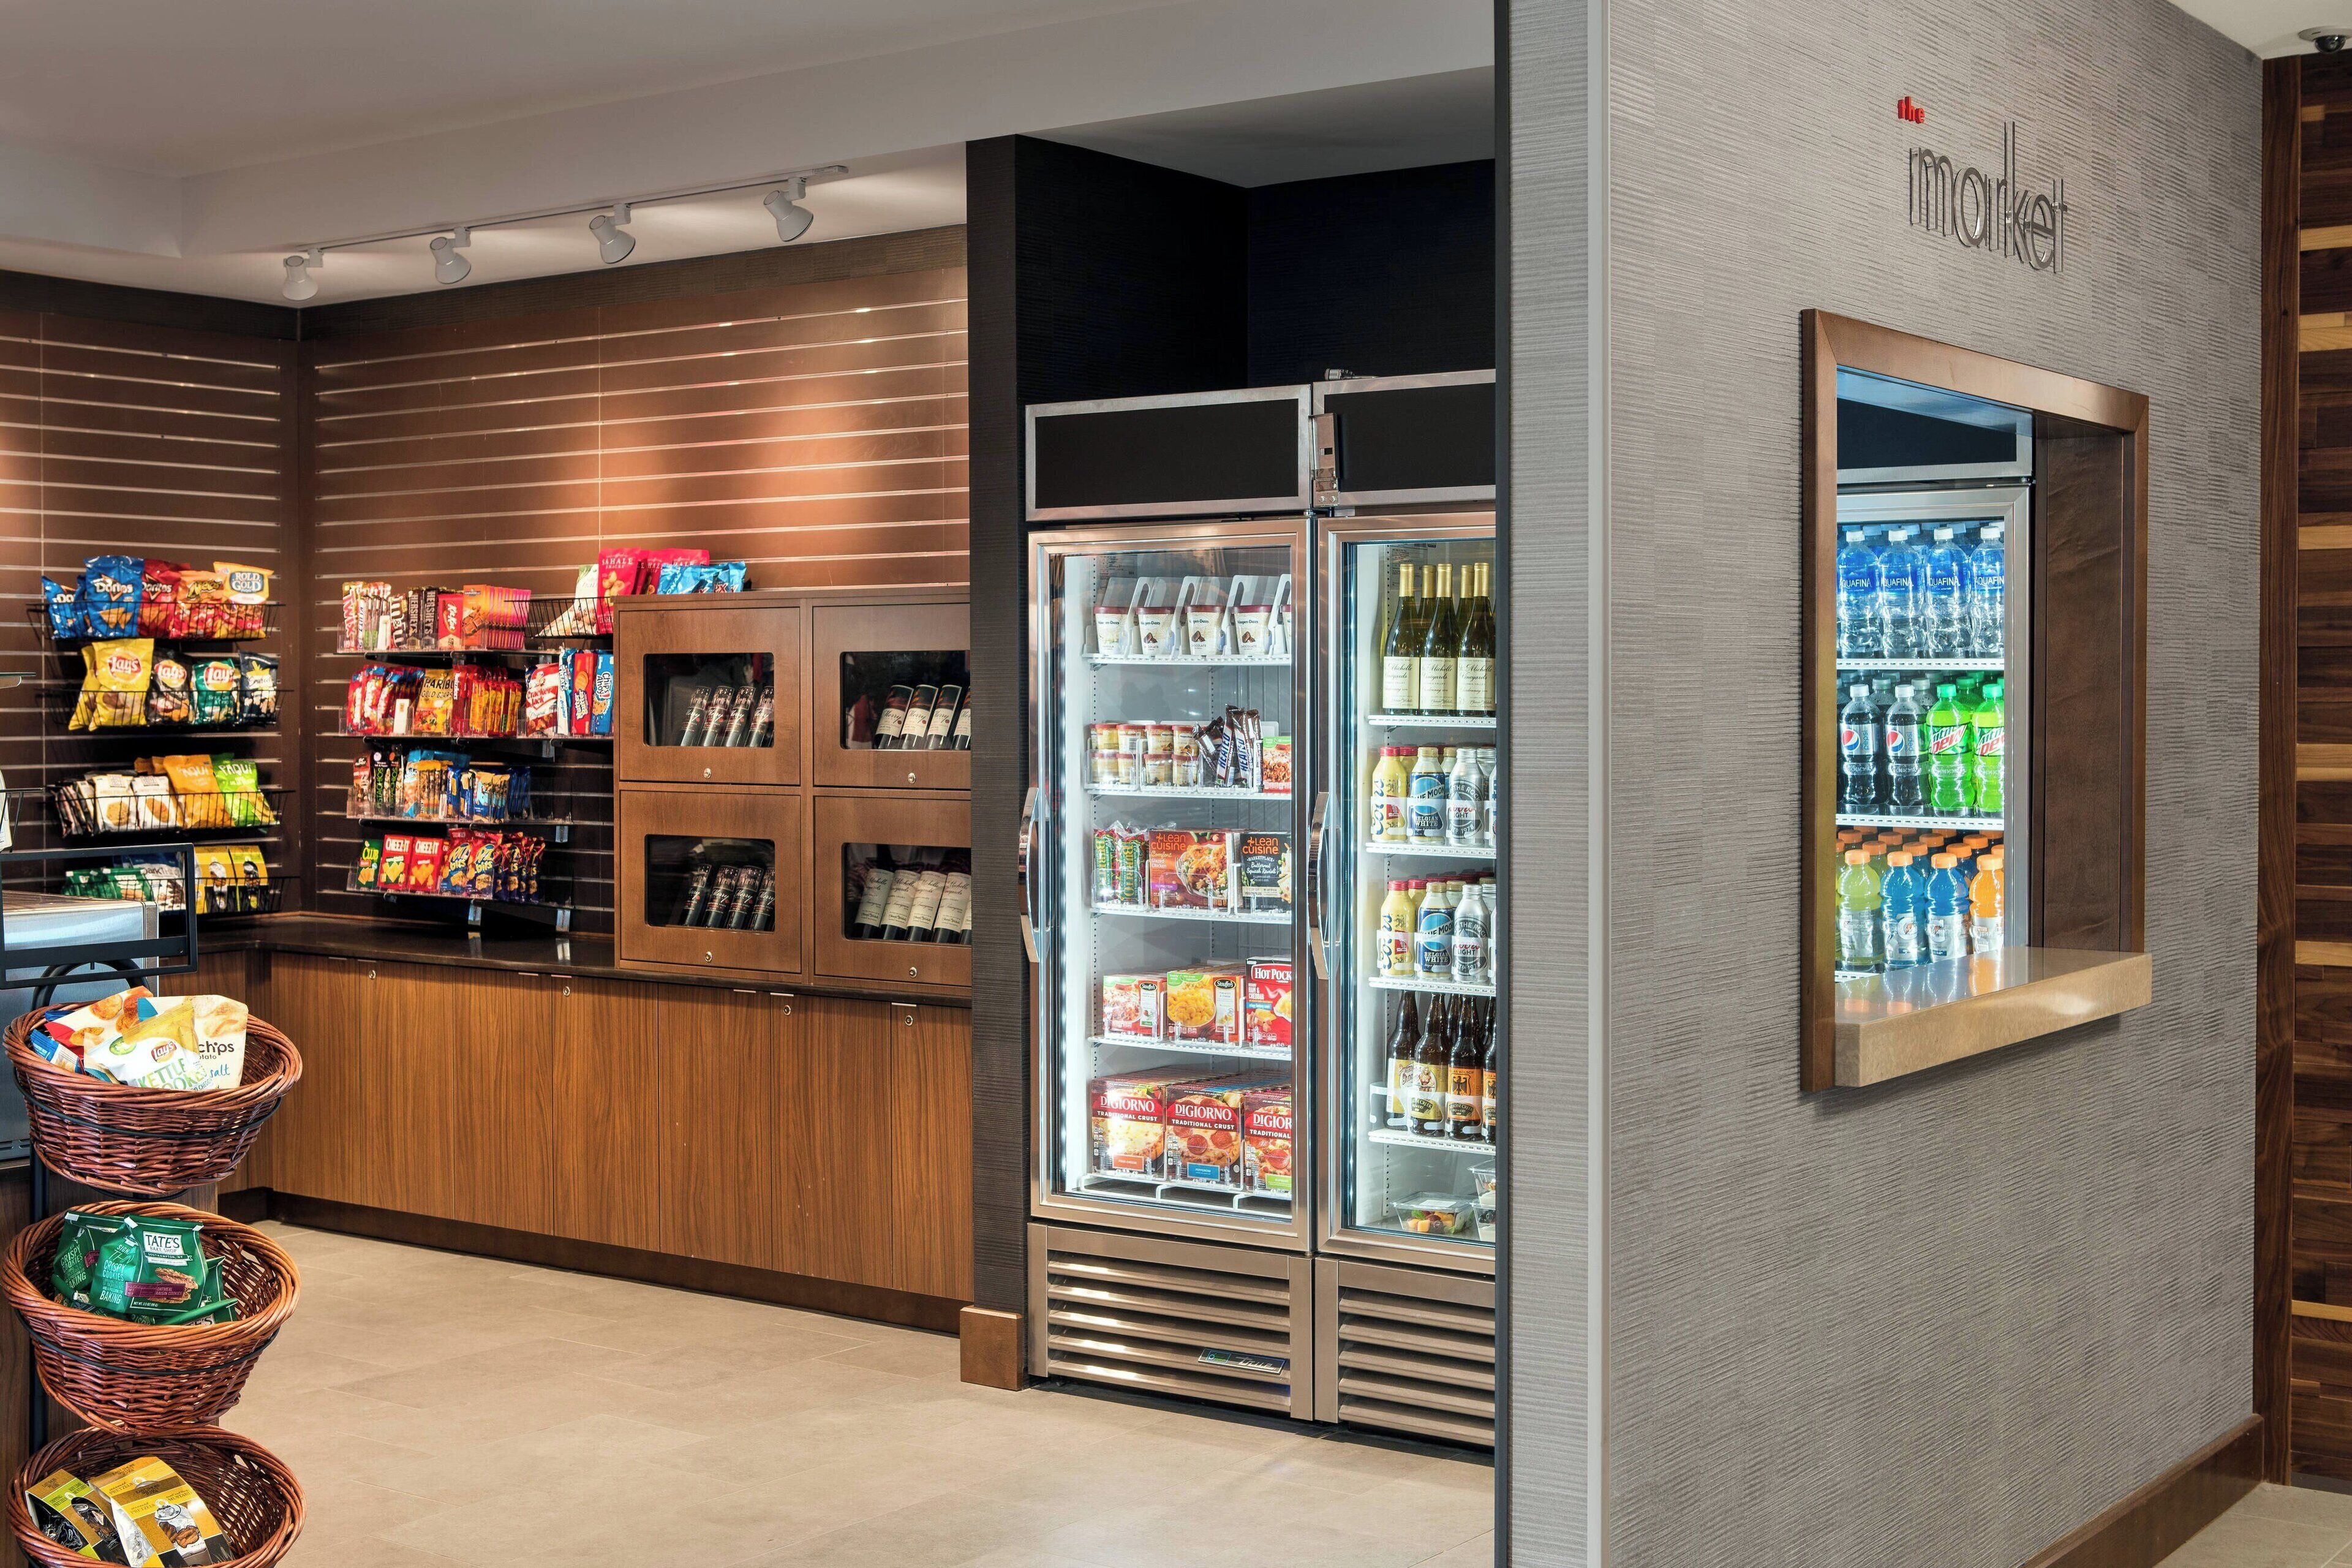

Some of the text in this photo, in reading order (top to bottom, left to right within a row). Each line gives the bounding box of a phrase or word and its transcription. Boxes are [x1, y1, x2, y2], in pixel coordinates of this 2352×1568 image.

[1898, 96, 1925, 124] the
[1909, 121, 2068, 274] market
[235, 572, 260, 581] ROLD
[96, 581, 134, 594] Doritos
[232, 581, 262, 592] GOLD
[342, 589, 355, 638] TWIX
[410, 592, 419, 634] HERSHEY'S
[424, 590, 437, 635] HERSHEY'S
[1466, 664, 1493, 673] Michelle
[602, 672, 611, 693] Chips
[527, 688, 554, 699] Cracker
[530, 696, 545, 707] Jack
[1931, 728, 1967, 755] DEW
[1427, 785, 1445, 799] MOON
[385, 838, 410, 853] CHEEZ-IT
[1164, 834, 1186, 843] Lean
[1255, 837, 1279, 846] Lean
[362, 847, 379, 861] CLUB
[415, 840, 440, 854] CHEEZ-IT
[1254, 967, 1292, 981] HOT POCK
[153, 1040, 177, 1061] Lay's
[199, 1041, 235, 1055] chips
[137, 1058, 186, 1088] KETTLE
[209, 1063, 231, 1078] salt
[1100, 1096, 1155, 1113] DIGIORNO
[1175, 1103, 1233, 1121] DIGIORNO
[1097, 1110, 1136, 1120] TRADITIONAL
[1253, 1112, 1292, 1130] DIGIOR
[1171, 1118, 1212, 1129] TRADITIONAL
[1250, 1129, 1291, 1139] TRADITIONAL
[145, 1234, 180, 1250] TATE'S
[61, 1244, 81, 1267] CRISPY
[104, 1259, 128, 1274] CRISPY
[66, 1272, 87, 1289] AKING
[102, 1269, 125, 1282] COOKIES
[99, 1290, 123, 1305] BAKING
[130, 1502, 156, 1516] PRETZELS
